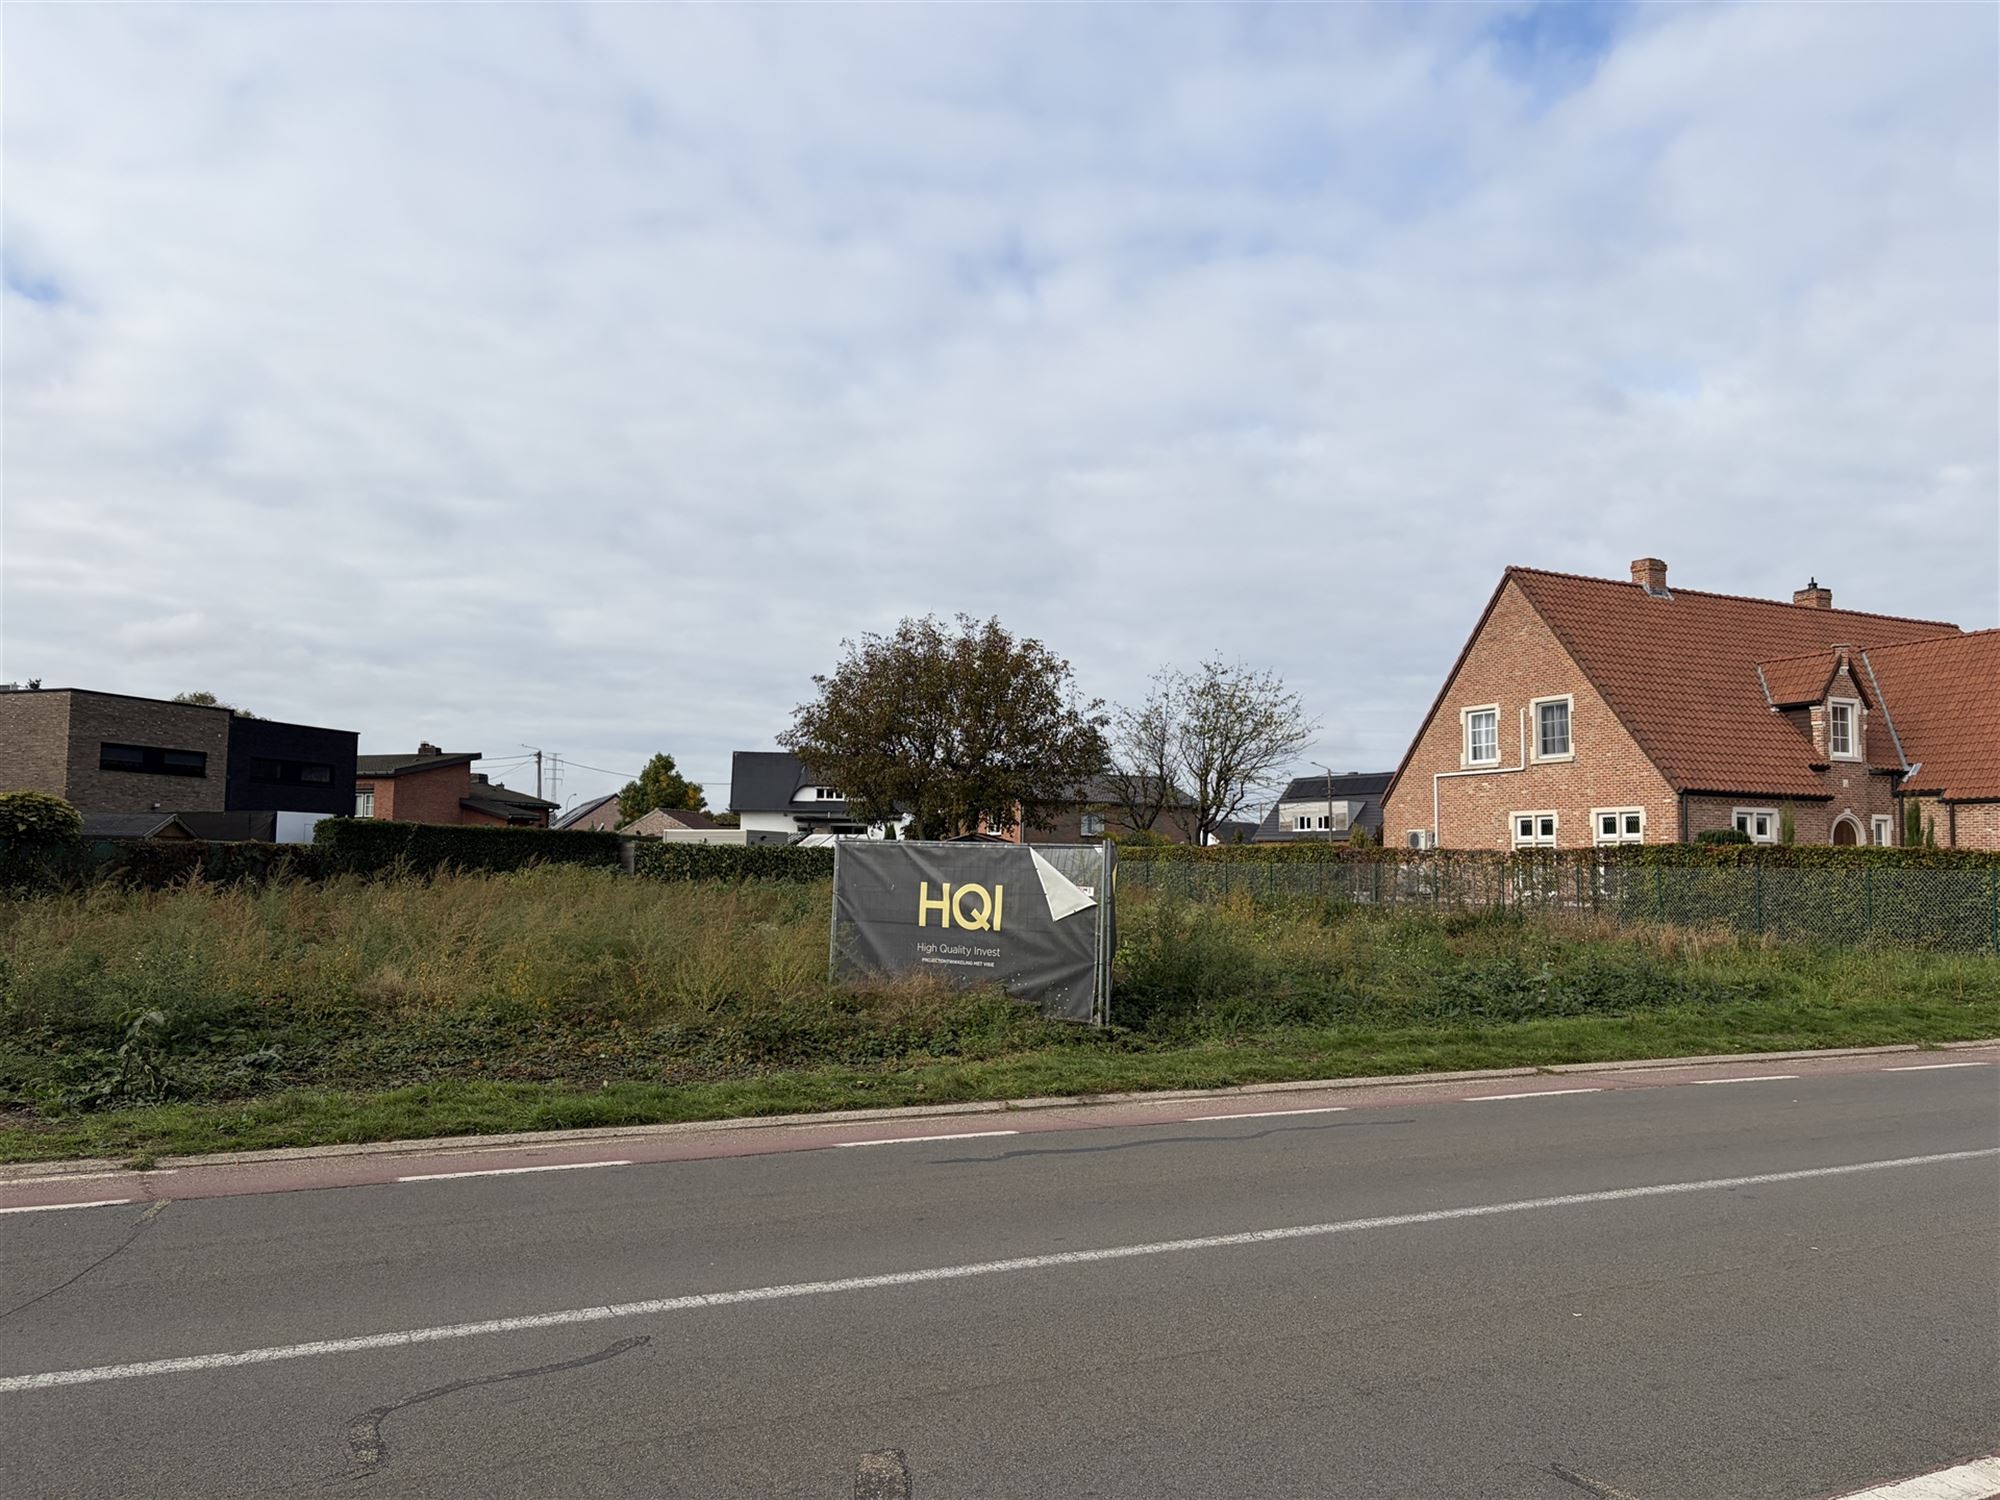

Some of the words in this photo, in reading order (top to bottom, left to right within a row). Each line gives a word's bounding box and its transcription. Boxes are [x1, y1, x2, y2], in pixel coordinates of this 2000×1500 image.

[919, 881, 1003, 931] HQI
[917, 942, 938, 954] High
[940, 943, 971, 957] Quality
[974, 946, 1000, 957] Invest
